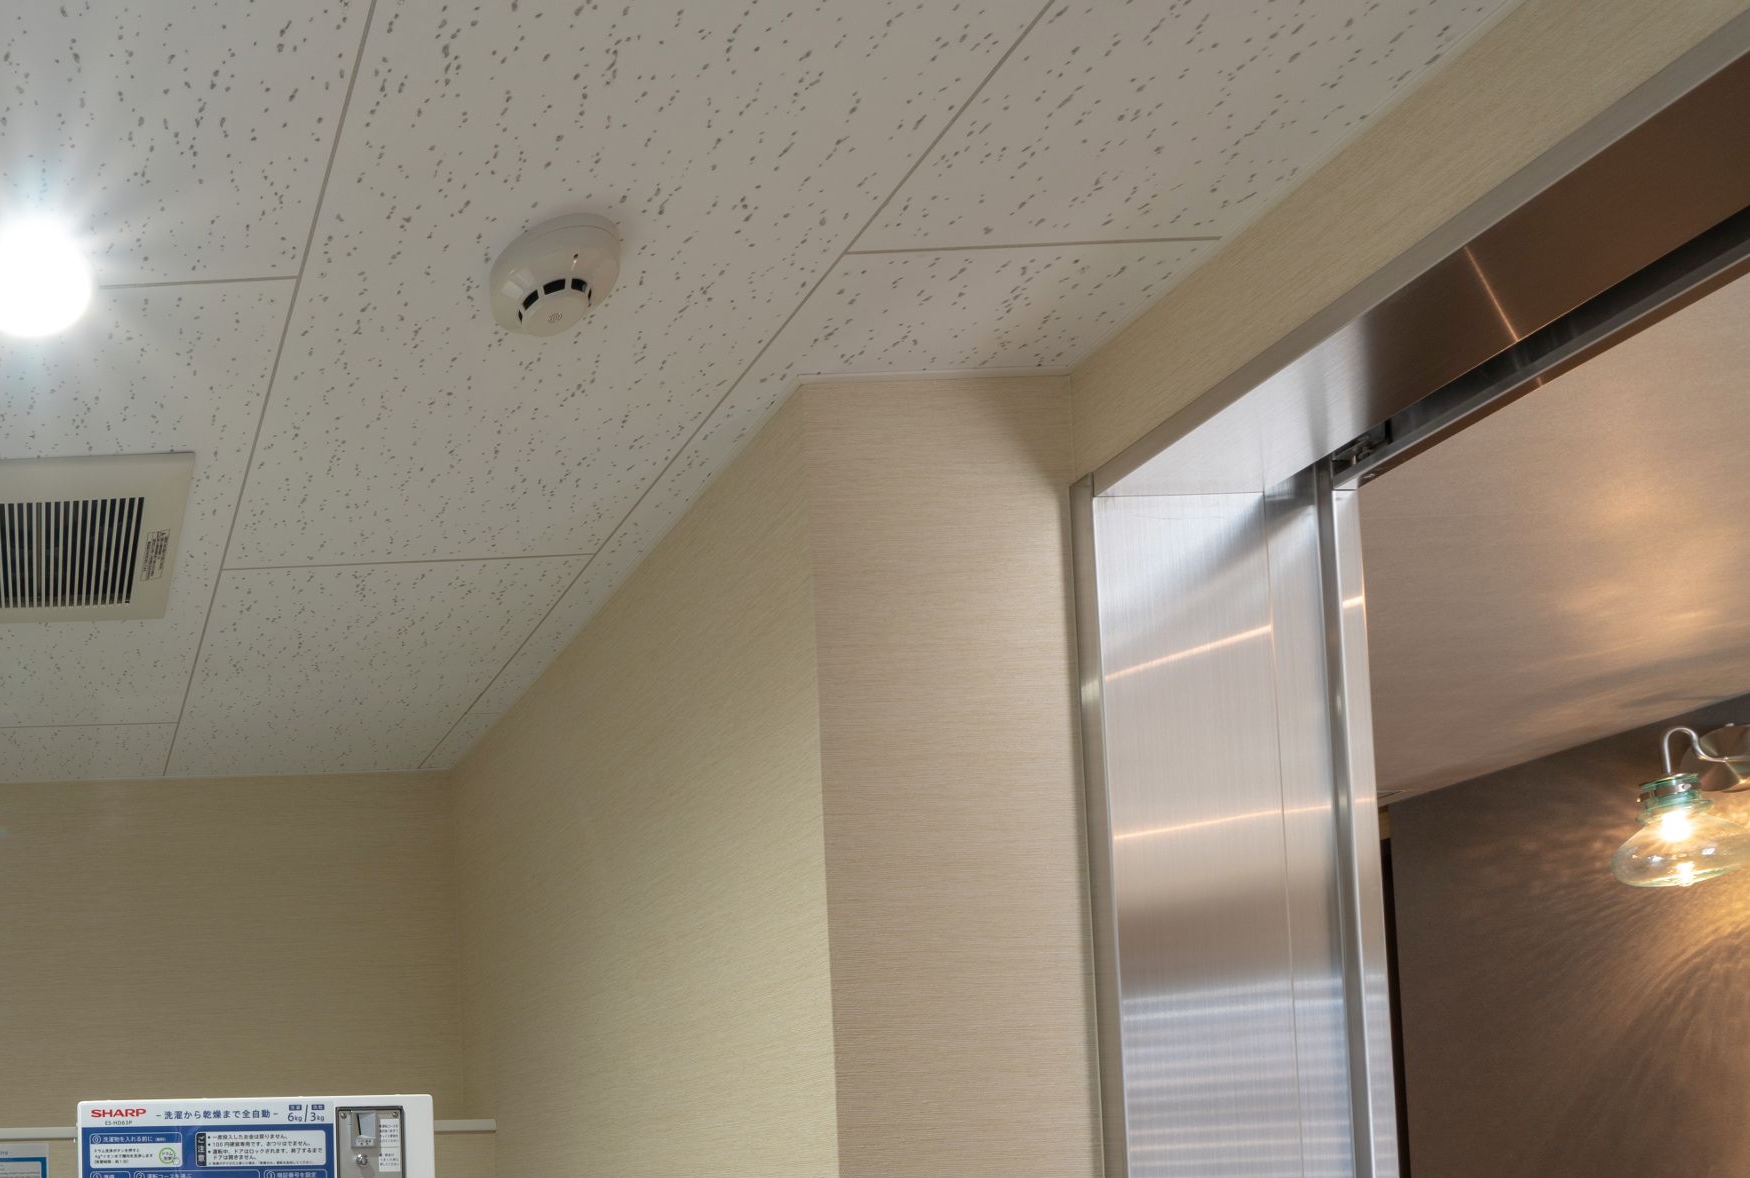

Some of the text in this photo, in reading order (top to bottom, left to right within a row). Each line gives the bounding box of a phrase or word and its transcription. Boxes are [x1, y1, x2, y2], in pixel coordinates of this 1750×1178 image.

[91, 1109, 146, 1117] SHARP
[164, 1109, 271, 1120] 洗濯から乾燥まで全自動
[288, 1111, 324, 1122] 6kg 3kg
